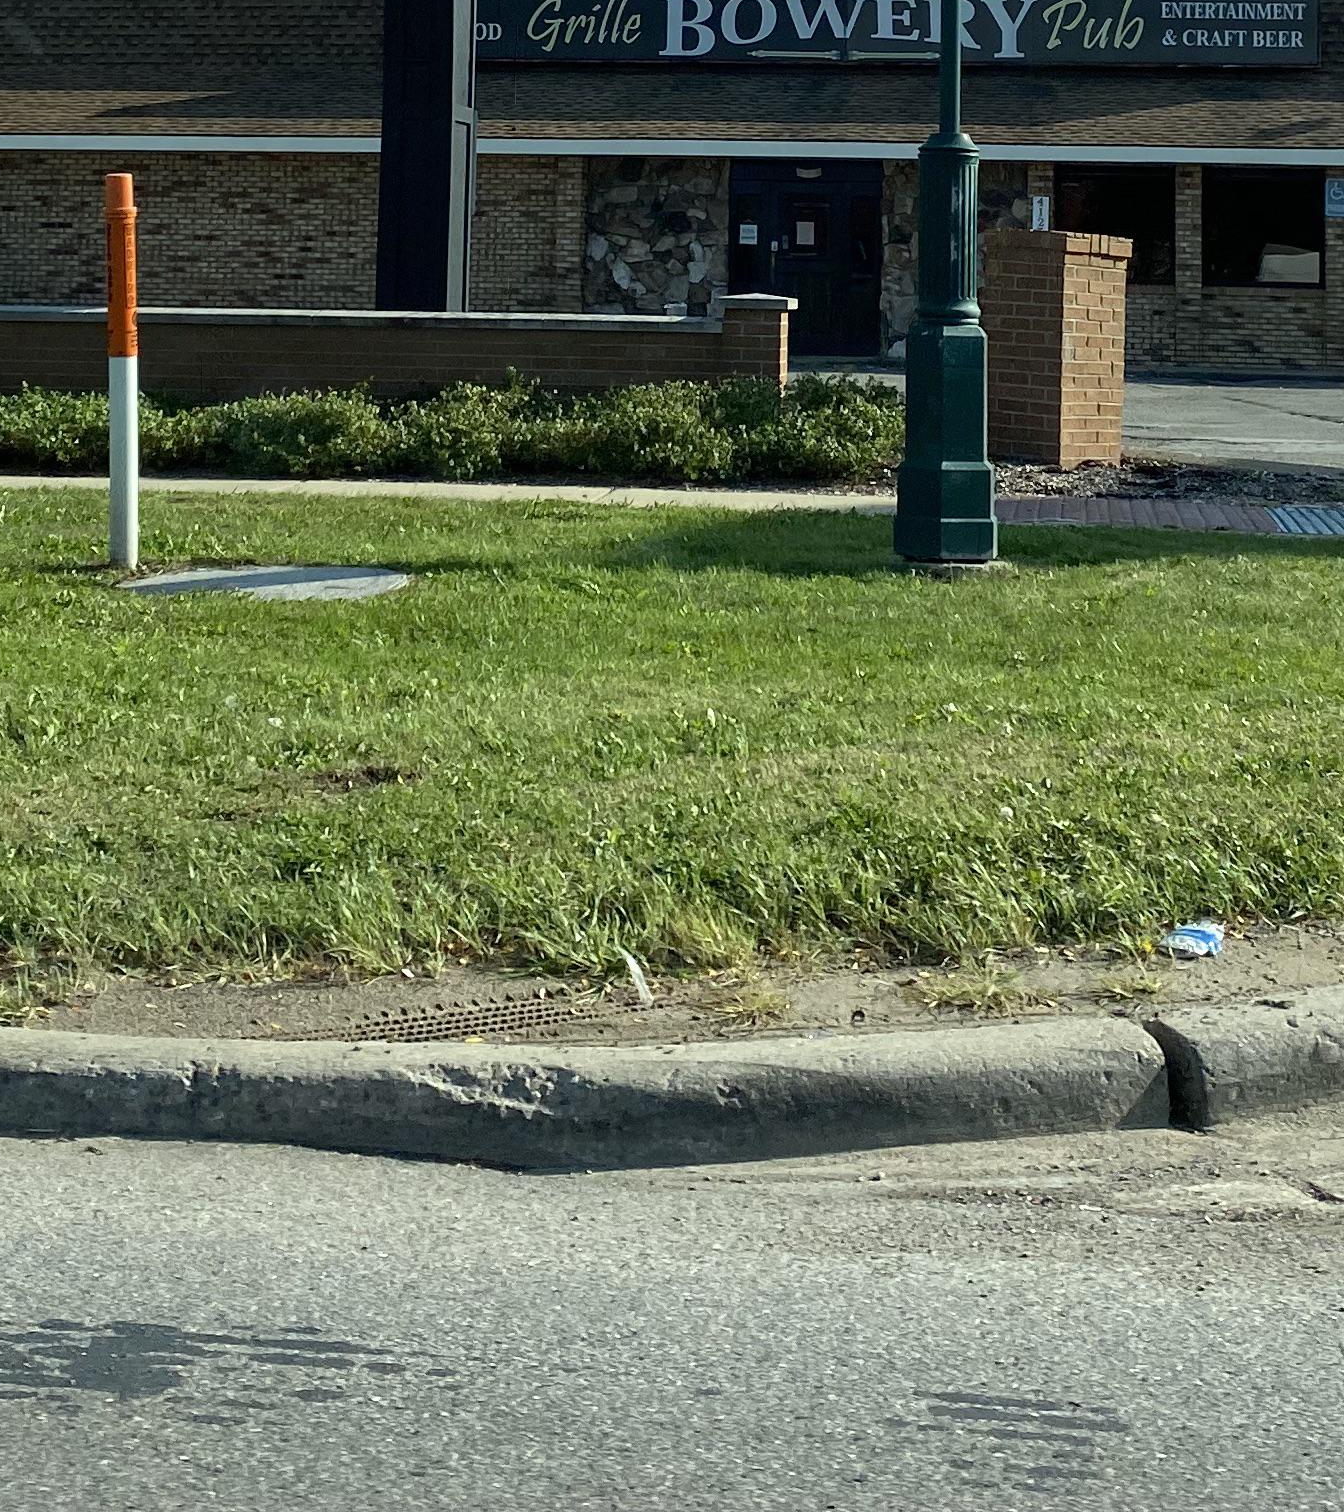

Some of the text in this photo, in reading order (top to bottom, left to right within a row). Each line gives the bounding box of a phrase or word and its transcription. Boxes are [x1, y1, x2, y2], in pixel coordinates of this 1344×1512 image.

[1160, 1, 1307, 20] ENTERTAINMENT
[1161, 28, 1304, 48] & CRAFT BEER
